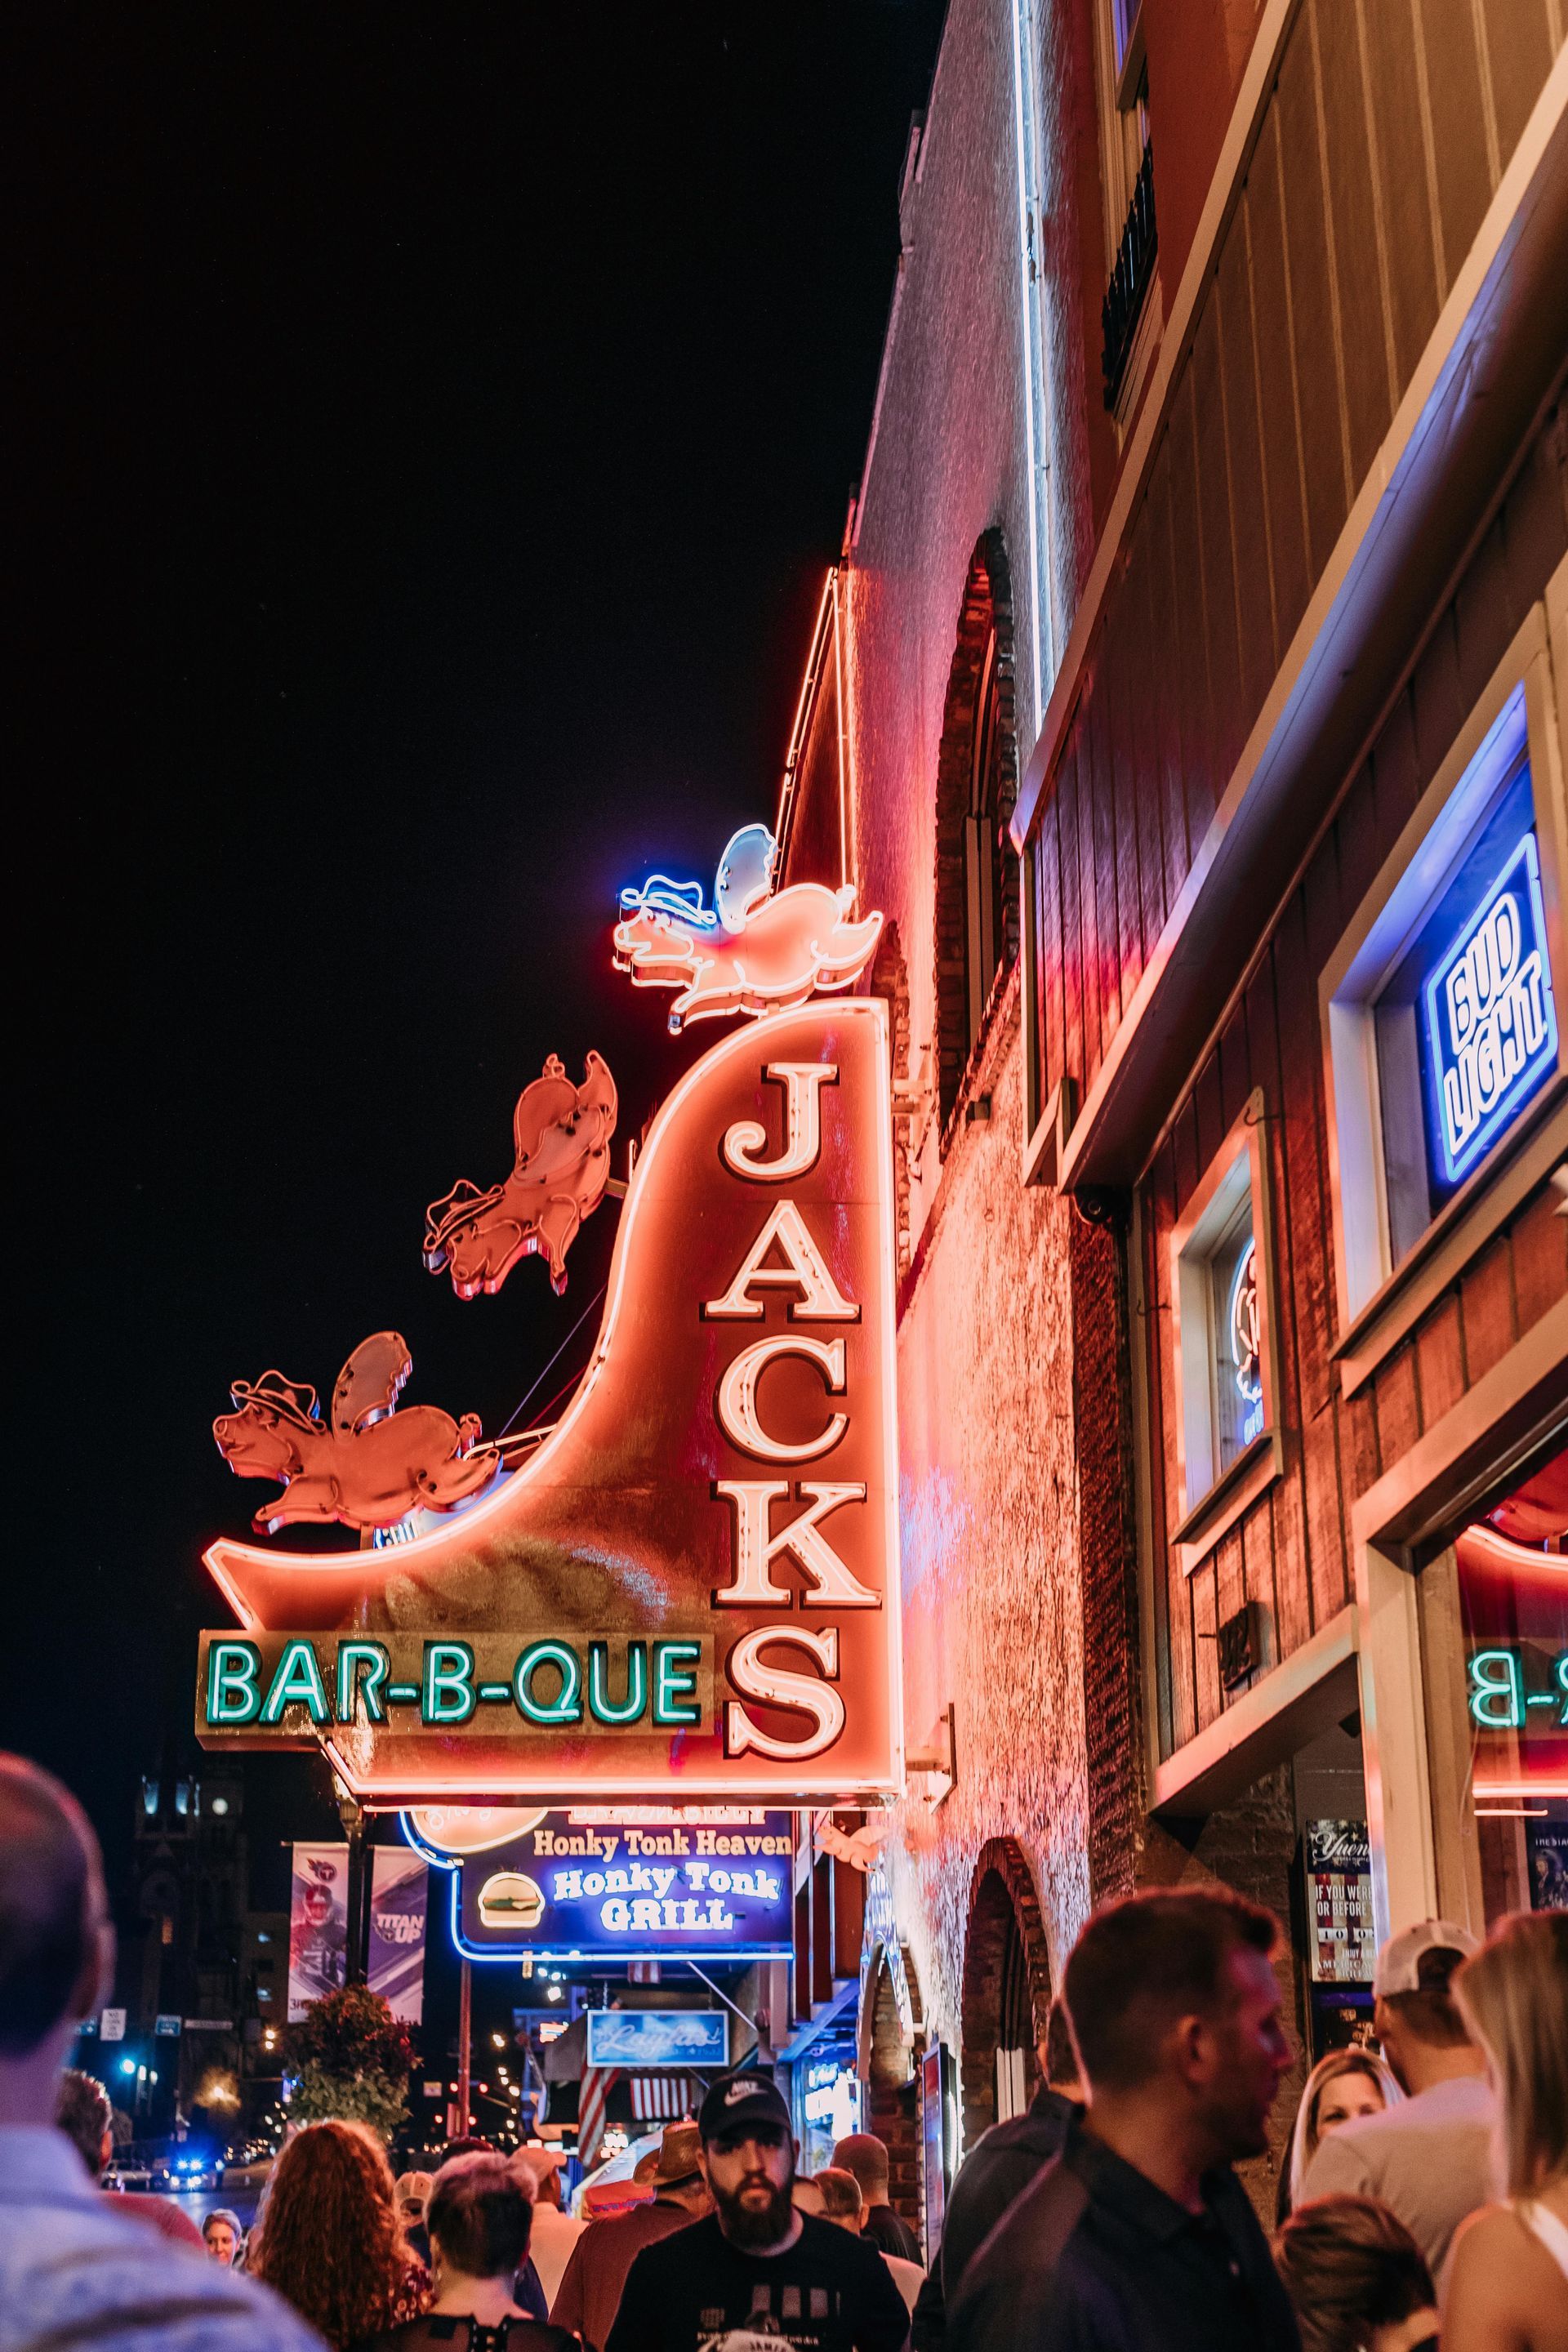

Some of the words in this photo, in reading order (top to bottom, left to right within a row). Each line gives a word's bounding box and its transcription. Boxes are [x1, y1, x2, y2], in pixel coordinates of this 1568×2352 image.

[1446, 893, 1521, 1056] BUD
[704, 1061, 881, 1759] JACKS
[207, 1639, 702, 1723] BAR-B-QUE
[533, 1829, 619, 1862] Honky
[624, 1829, 690, 1855] Tonk
[696, 1830, 792, 1855] Heaven
[554, 1863, 675, 1900] Honky
[684, 1862, 780, 1900] Tonk
[1316, 1885, 1323, 1901] IF
[1326, 1885, 1345, 1900] YOU
[376, 1913, 424, 1928] TITAN
[600, 1898, 733, 1932] GRILL
[1316, 1900, 1330, 1917] OR
[1332, 1900, 1366, 1917] BEFORE
[395, 1927, 421, 1944] UP
